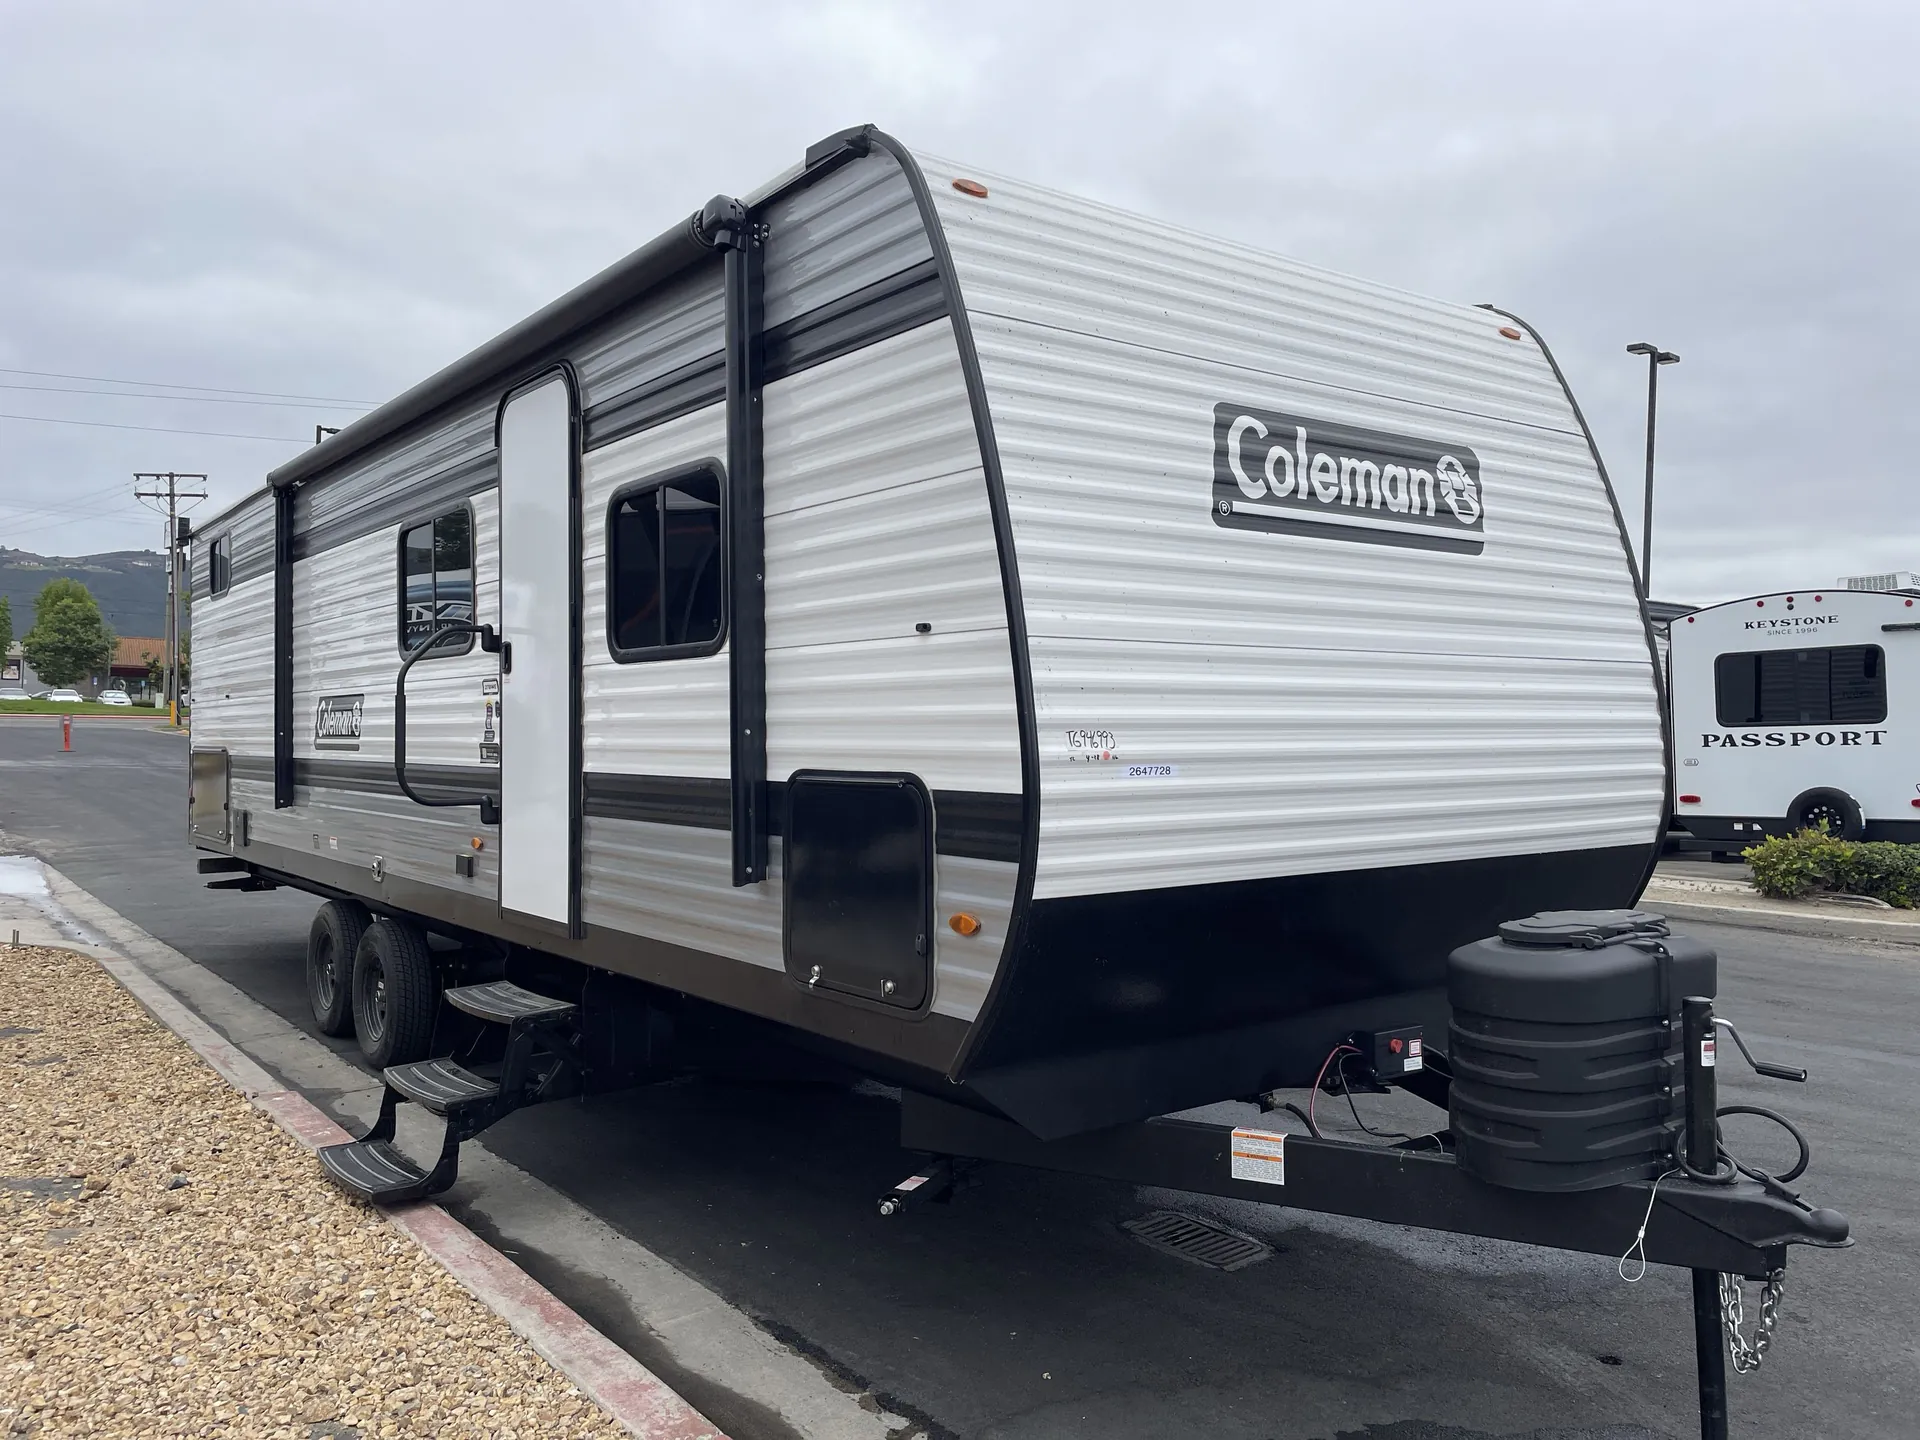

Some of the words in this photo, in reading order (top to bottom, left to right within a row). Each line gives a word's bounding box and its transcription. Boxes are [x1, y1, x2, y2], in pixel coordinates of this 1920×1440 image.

[1227, 415, 1436, 517] Coleman
[1744, 615, 1839, 630] KEYSTONE
[317, 700, 352, 737] Coleman
[1701, 730, 1887, 748] PASSPORT
[1129, 766, 1171, 776] 2647728
